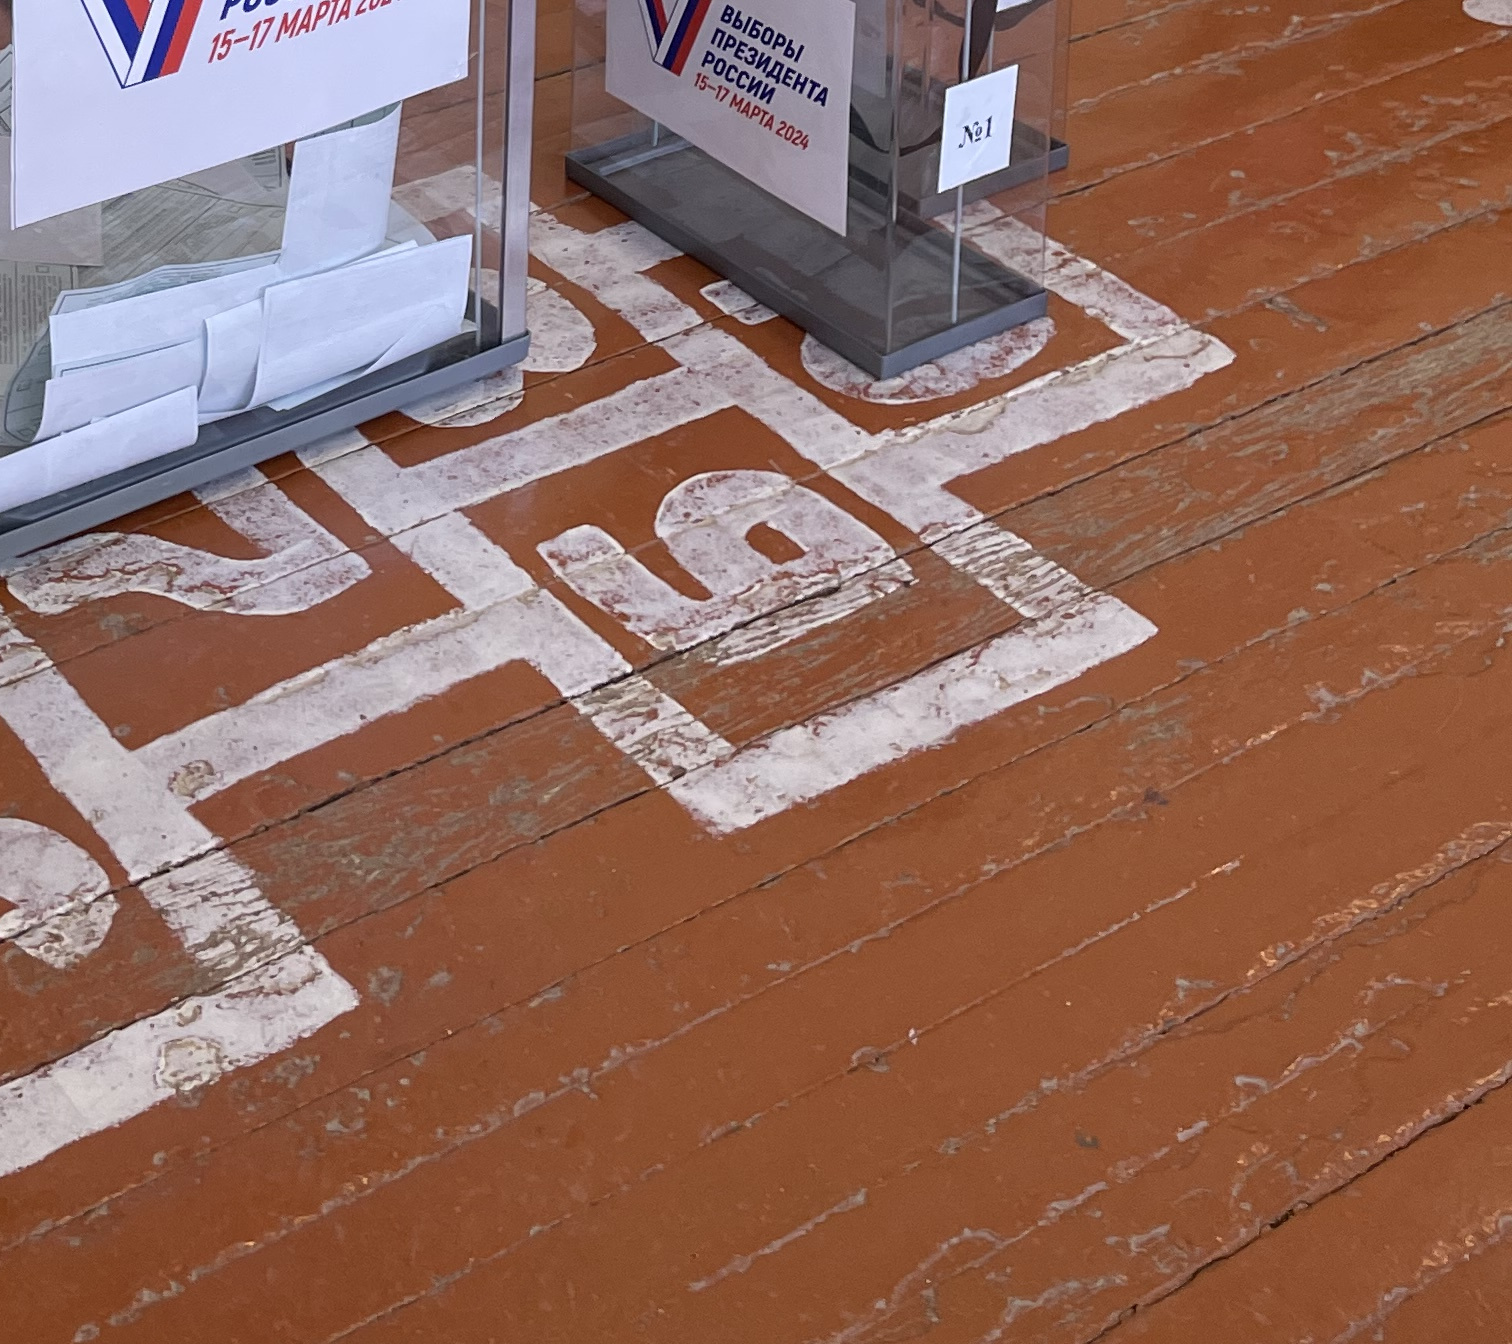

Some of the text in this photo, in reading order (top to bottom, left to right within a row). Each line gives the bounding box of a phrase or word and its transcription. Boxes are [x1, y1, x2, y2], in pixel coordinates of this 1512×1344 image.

[208, 16, 276, 63] 15–17
[720, 4, 805, 62] ВЫБОРЫ
[701, 51, 776, 104] РОССИИ
[710, 28, 829, 107] ПРЕЗИДЕНТА
[694, 73, 809, 150] 15–17 МАРТА 2024
[958, 116, 993, 148] №1
